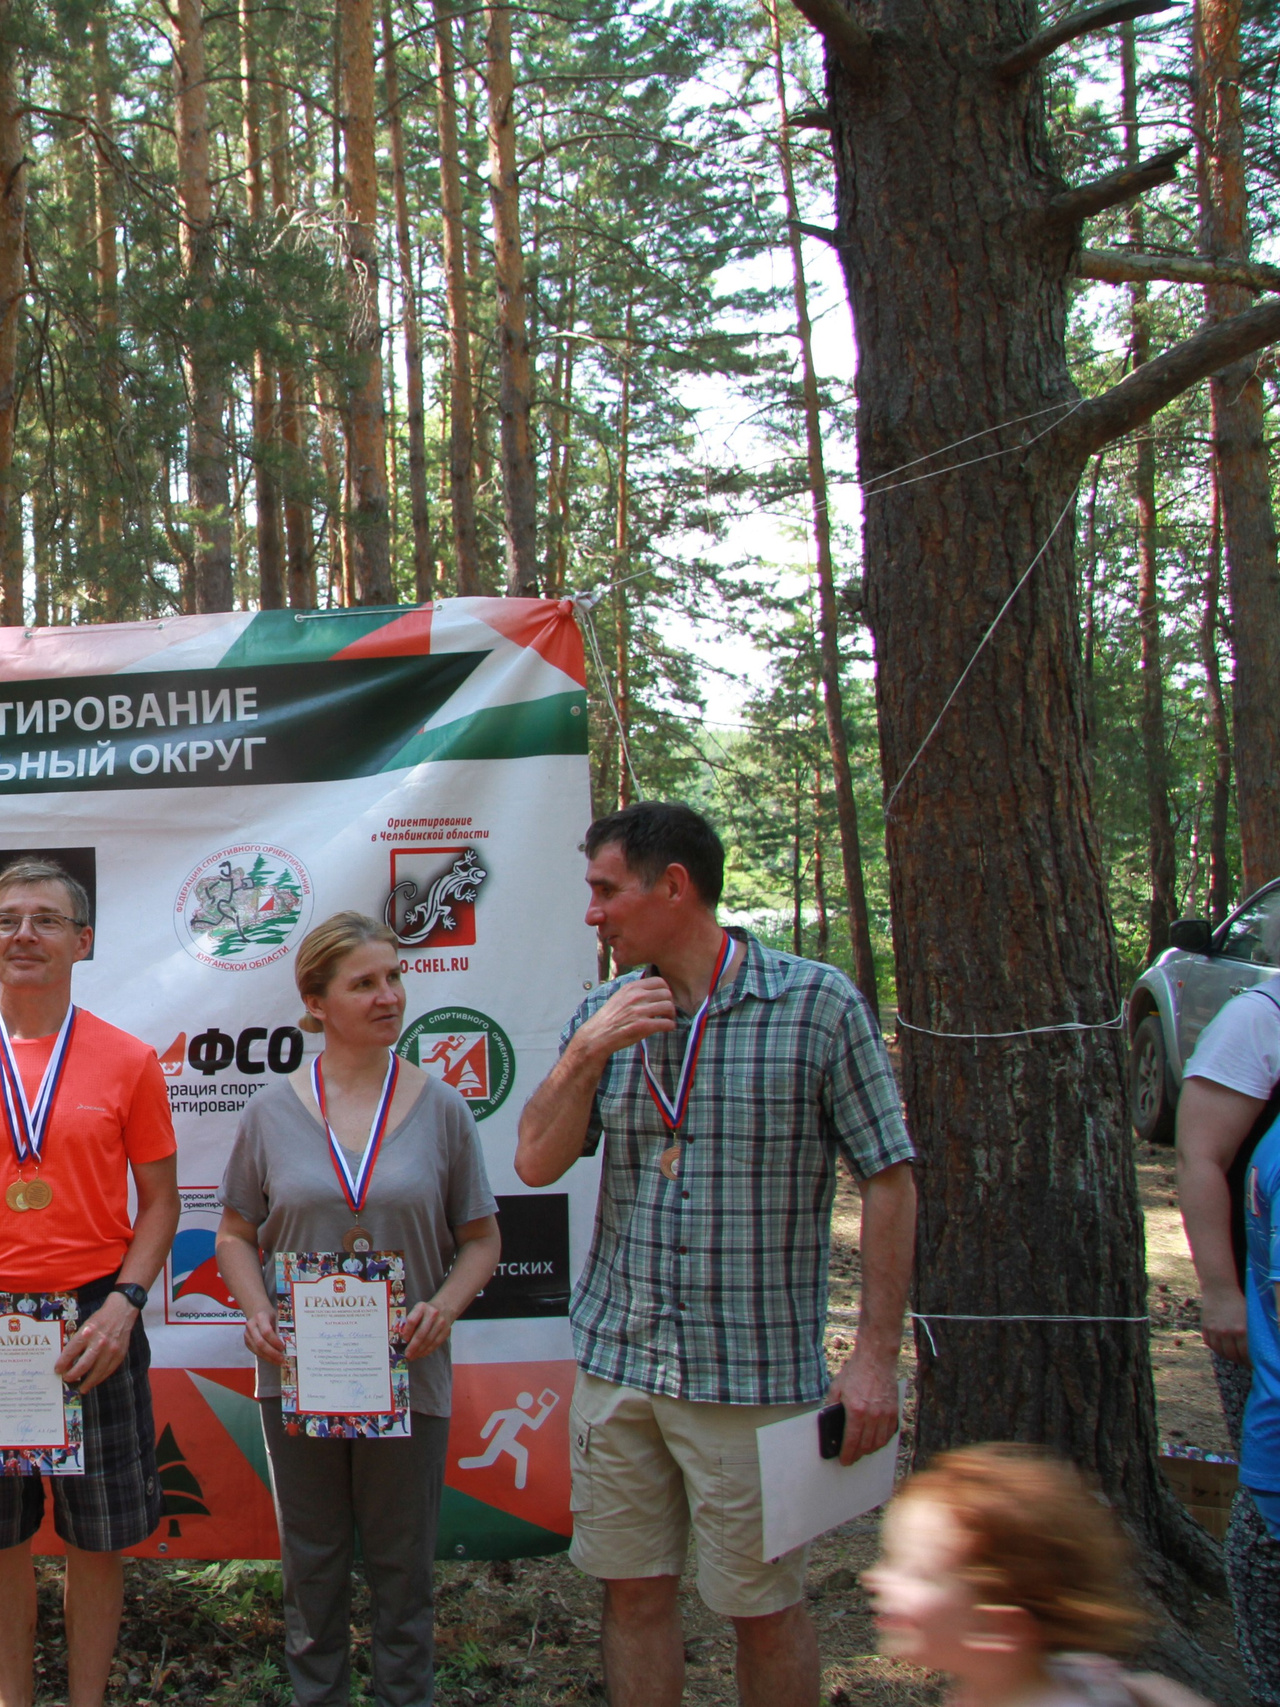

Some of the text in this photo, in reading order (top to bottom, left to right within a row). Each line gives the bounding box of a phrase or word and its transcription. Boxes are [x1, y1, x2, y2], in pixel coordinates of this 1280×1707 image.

[128, 737, 267, 775] ОКРУГ
[387, 816, 473, 829] Ориентирование
[371, 829, 490, 842] в Челябинской области
[176, 845, 311, 913] ФЕДЕРАЦИЯ СПОРТИВНОГО ОРИЕНТИРОВАНИЯ
[195, 945, 290, 971] КУРГАНСКОЙ ОБЛАСТИ
[187, 1025, 304, 1077] ФСО
[400, 1011, 510, 1106] ДЕРАЦИЯ СПОРТИВНОГО ОРИЕНТИРОВАНИЯ
[171, 1100, 248, 1117] нтирован
[496, 1261, 554, 1276] ТСКИХ
[303, 1295, 378, 1308] ГРАМОТА
